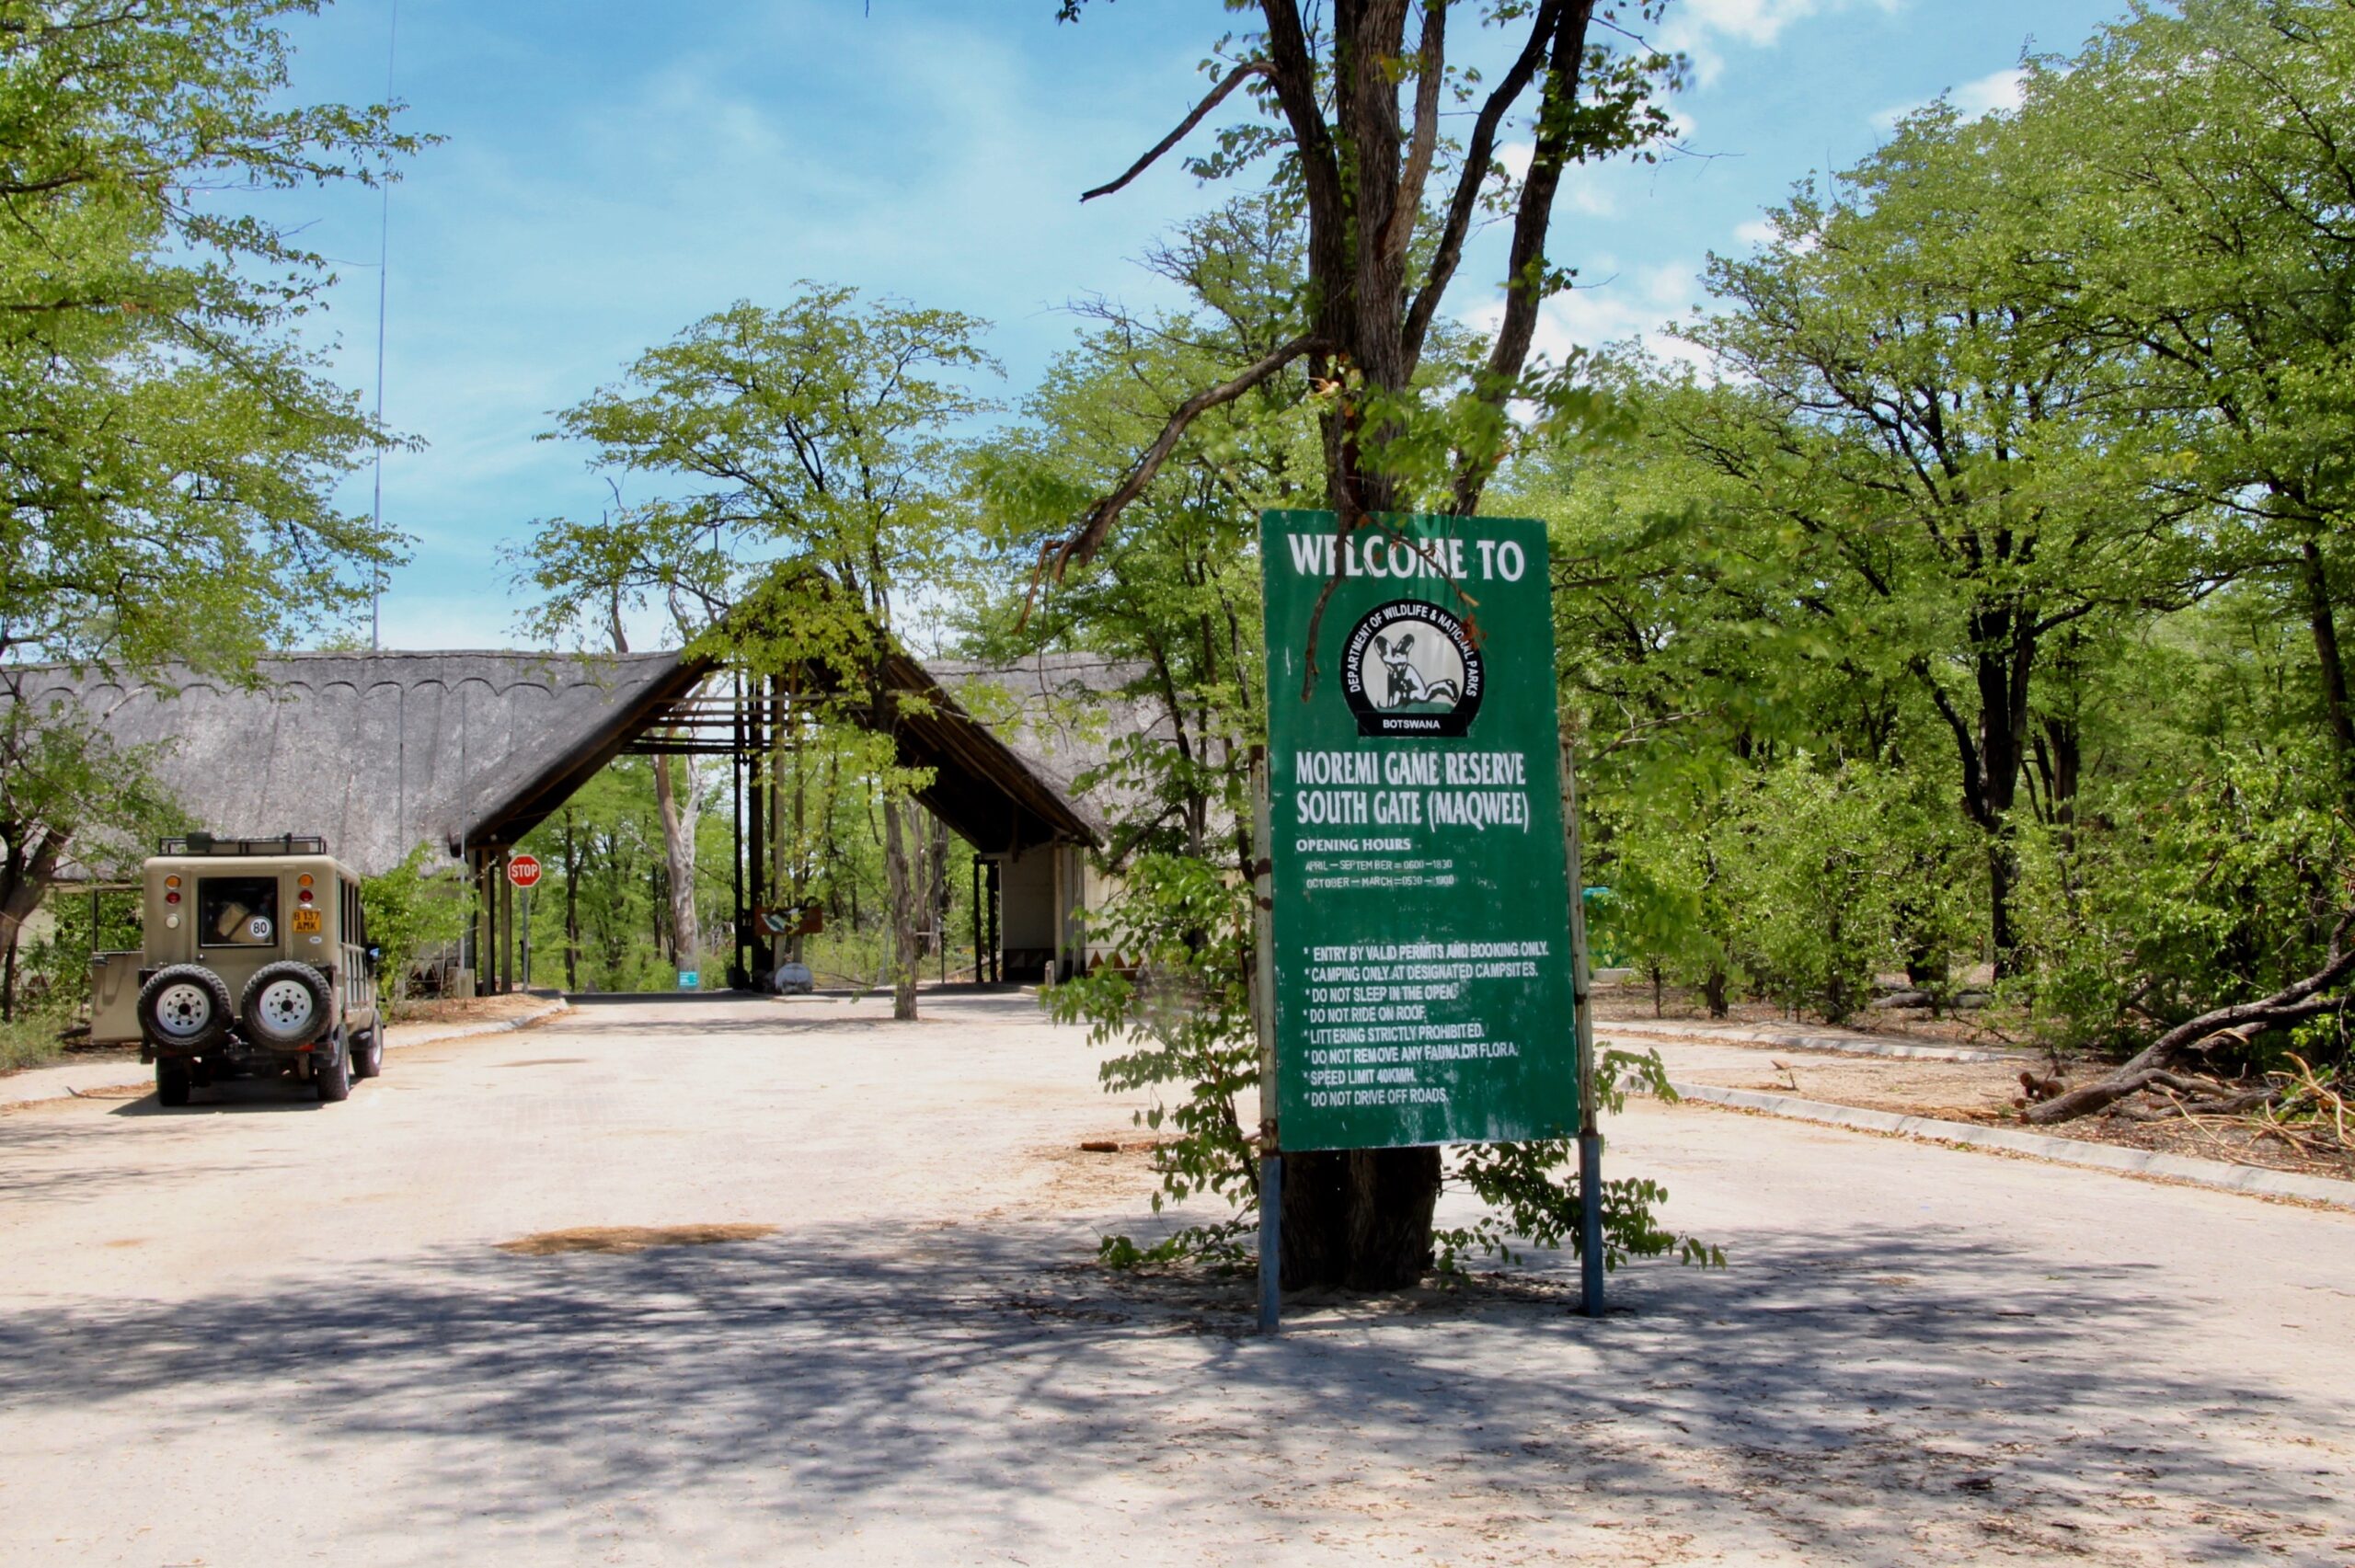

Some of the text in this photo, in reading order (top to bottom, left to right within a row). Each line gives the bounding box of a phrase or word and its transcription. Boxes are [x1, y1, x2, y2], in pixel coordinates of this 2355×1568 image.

[1287, 533, 1525, 582] WELCOME TO
[1348, 623, 1373, 693] DEPARTMENT
[1370, 612, 1383, 627] OF
[1383, 604, 1429, 620] WILDLIFE
[1430, 609, 1437, 620] &
[1465, 660, 1479, 697] PARKS
[1383, 719, 1441, 729] BOTSWANA
[1296, 751, 1526, 785] MOREMI GAME RESERVE
[1296, 790, 1529, 833] SOUTH GATE (MAQWEE)
[1296, 838, 1411, 853] OPENING HOURS
[511, 864, 538, 878] STOP
[253, 921, 268, 933] 80
[1314, 941, 1549, 962] ENTRY BY VALID PERMITS AND BOOKING ONLY.
[1312, 967, 1360, 982] CAMPING
[1391, 966, 1406, 981] AT
[1407, 964, 1473, 980] DESIGNATED
[1476, 962, 1538, 978] CAMPSITES.
[1312, 988, 1327, 1003] DO
[1329, 987, 1352, 1002] NOT
[1353, 986, 1387, 1002] SLEEP
[1389, 986, 1401, 1001] IN
[1403, 985, 1423, 1001] THE
[1310, 1008, 1326, 1024] DO
[1327, 1008, 1349, 1023] NOT
[1351, 1006, 1376, 1023] RIDE
[1378, 1006, 1395, 1022] ON
[1310, 1024, 1485, 1045] LITTERING STRICTLY PROHIBITED.
[1311, 1049, 1327, 1065] DO
[1328, 1048, 1352, 1064] NOT
[1353, 1047, 1399, 1063] REMOVE
[1401, 1047, 1423, 1061] ANY
[1310, 1070, 1346, 1085] SPEED
[1348, 1069, 1374, 1084] LIMIT
[1311, 1092, 1327, 1106] DO
[1329, 1091, 1352, 1106] NOT
[1353, 1089, 1385, 1105] DRIVE
[1387, 1088, 1408, 1104] OFF
